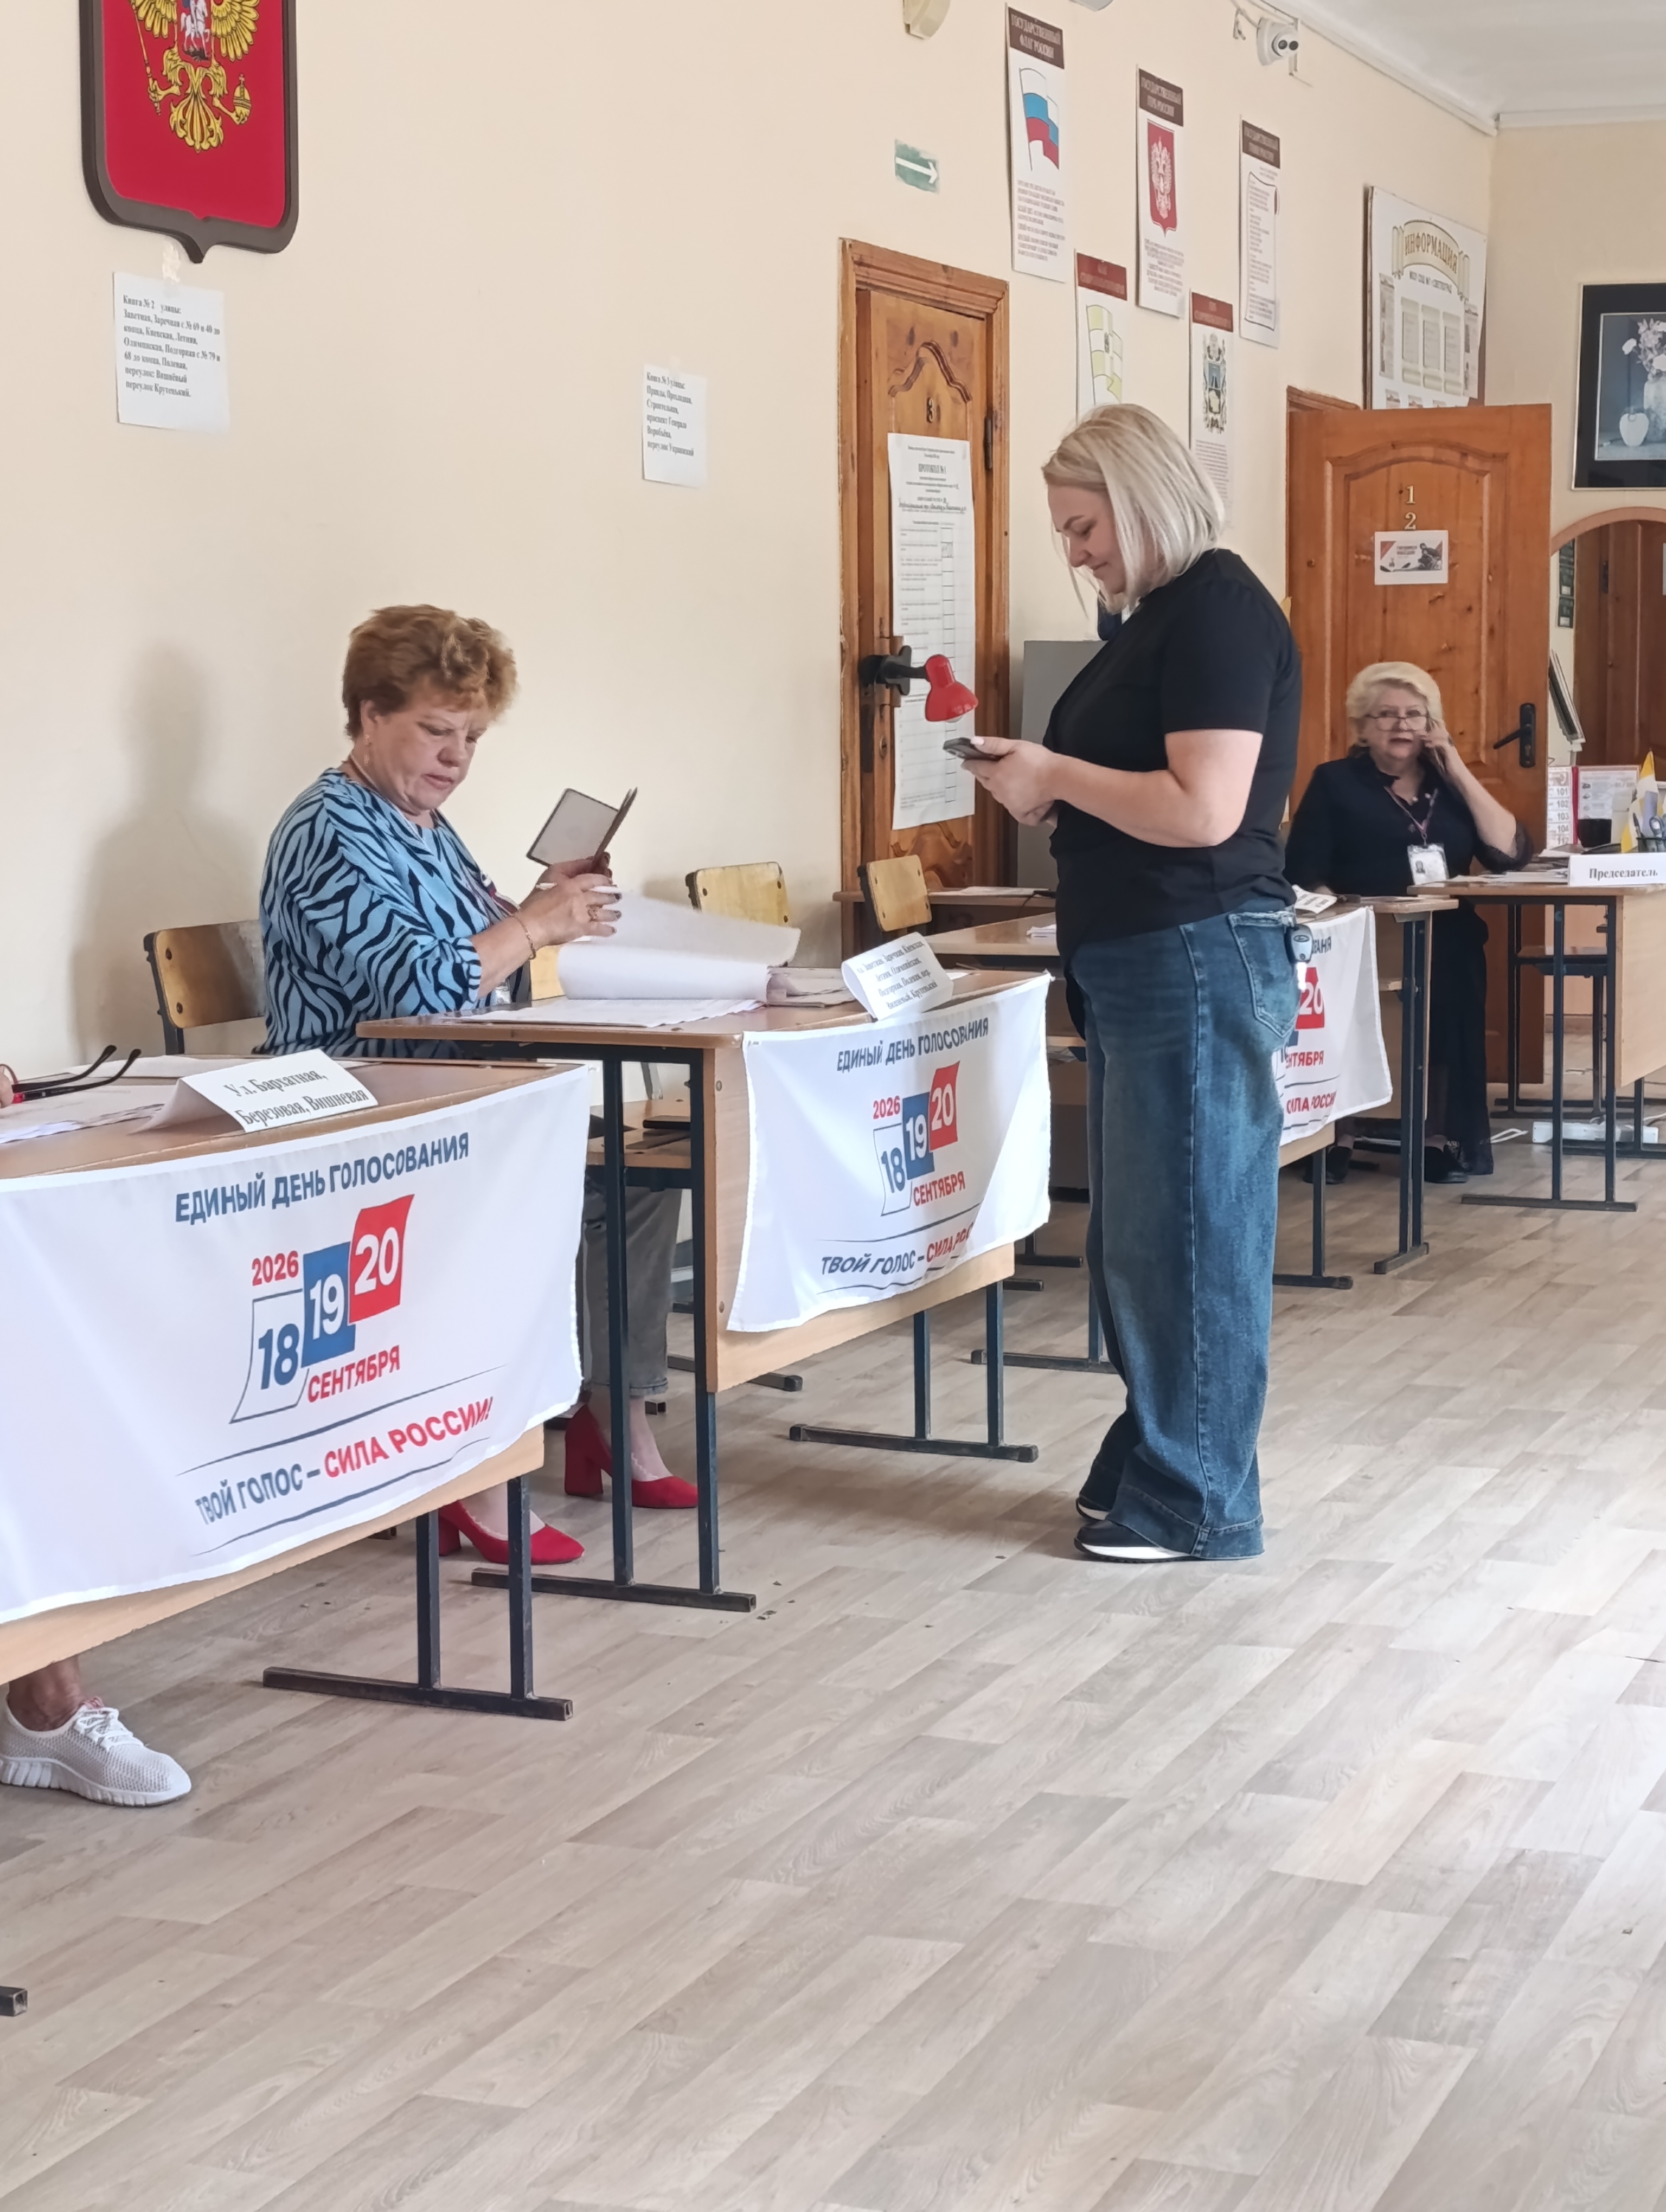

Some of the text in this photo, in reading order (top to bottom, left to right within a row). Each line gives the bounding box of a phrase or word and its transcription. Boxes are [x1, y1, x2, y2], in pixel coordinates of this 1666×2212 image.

[1405, 232, 1457, 274] ИНФОРМАЦИЯ
[123, 294, 142, 307] Книга
[151, 300, 155, 309] 2
[153, 314, 180, 327] Заречная
[124, 351, 131, 360] 68
[1406, 485, 1416, 504] 1
[1404, 512, 1417, 530] 2
[1557, 788, 1568, 796] 101
[1558, 812, 1569, 820] 103
[1588, 867, 1658, 880] Председатель
[1299, 981, 1323, 1015] 20
[837, 1017, 989, 1073] ЕДИНЫЙ ДЕНЬ ГОЛОСОВАНИЯ
[223, 1070, 329, 1097] Ул. Бархатная,
[234, 1089, 370, 1127] Березовая, Вишневая
[873, 1095, 901, 1120] 2026
[931, 1083, 954, 1131] 20
[906, 1114, 928, 1161] 19
[175, 1131, 469, 1225] ЕДИНЫЙ ДЕНЬ ГОЛОСОВАНИЯ
[881, 1147, 906, 1193] 18
[913, 1171, 966, 1207] СЕНТЯБРЯ
[252, 1250, 299, 1287] 2026
[354, 1226, 400, 1296] 20
[822, 1253, 873, 1275] ТВОЙ
[869, 1250, 916, 1275] ГОЛОС
[926, 1235, 953, 1263] СИЛА
[310, 1274, 345, 1340] 19
[258, 1323, 300, 1390] 18
[308, 1345, 400, 1403] СЕНТЯБРЯ
[195, 1479, 238, 1526] ТВОЙ
[237, 1463, 303, 1509] ГОЛОС
[324, 1436, 389, 1478] СИЛА
[388, 1396, 494, 1454] РОССИИ!
